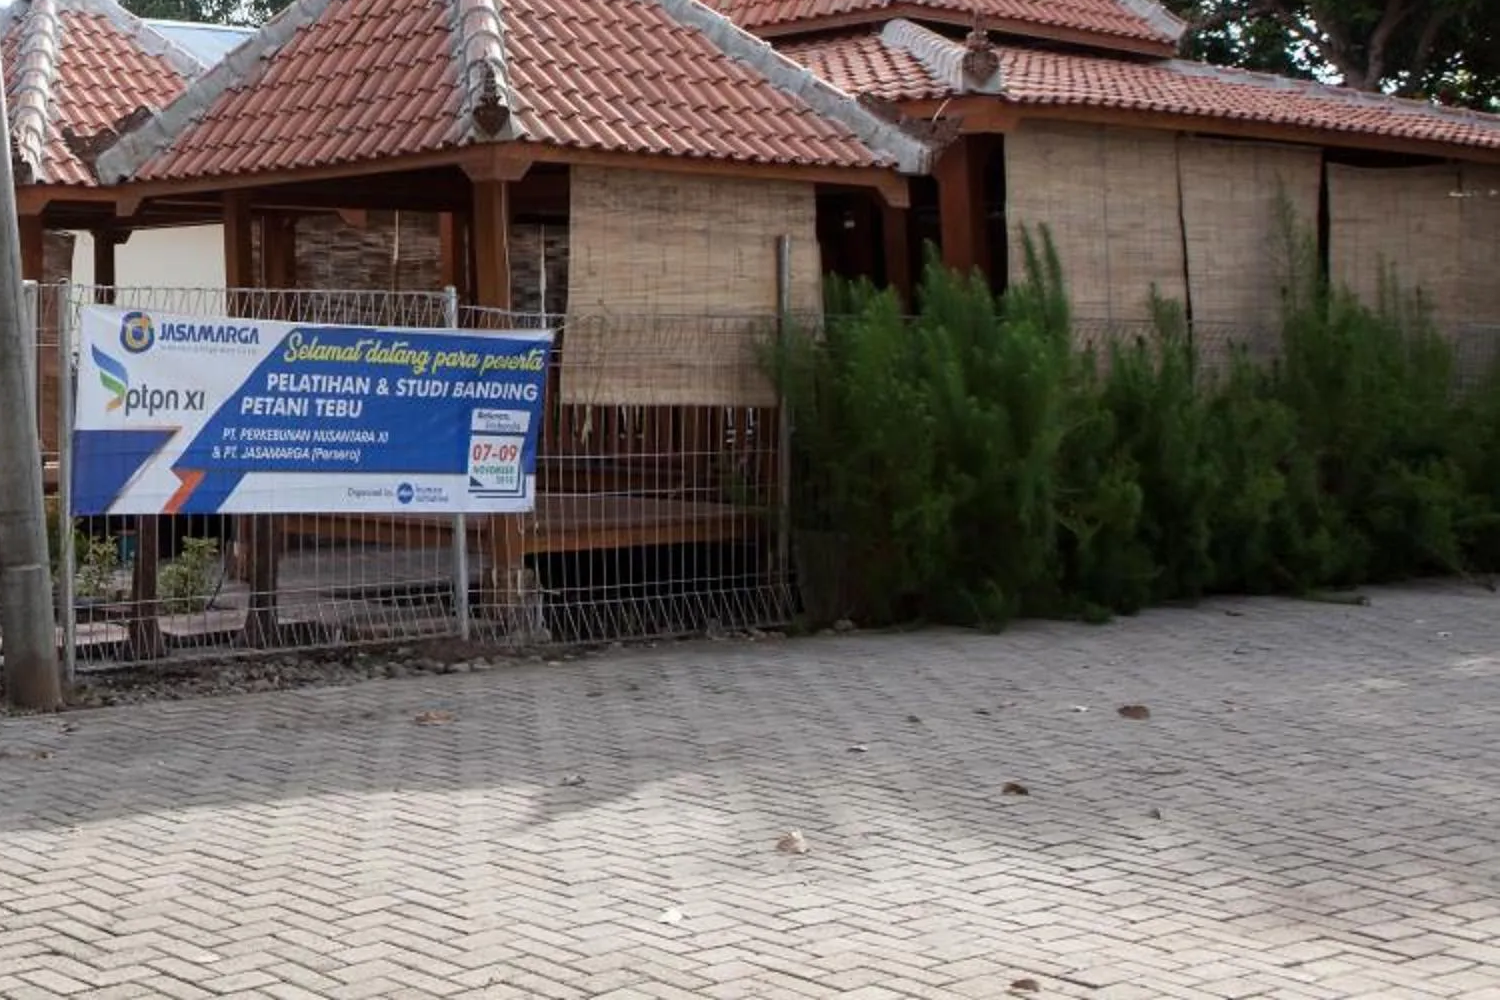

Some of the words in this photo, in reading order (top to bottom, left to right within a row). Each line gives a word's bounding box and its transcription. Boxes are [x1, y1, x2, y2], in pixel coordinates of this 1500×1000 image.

[159, 324, 260, 345] JASAMARGA
[284, 331, 372, 363] Selamat
[365, 338, 428, 374] datang
[431, 350, 480, 374] para
[267, 373, 371, 395] PELATIHAN
[376, 378, 389, 395] &
[396, 378, 449, 397] STUDI
[452, 381, 538, 401] BANDING
[125, 384, 179, 417] ptpn
[241, 396, 309, 416] PETANI
[315, 398, 363, 418] TEBU
[239, 428, 310, 441] PERKEBUNAN
[312, 429, 375, 443] NUSANTARA
[473, 443, 517, 462] 07-09
